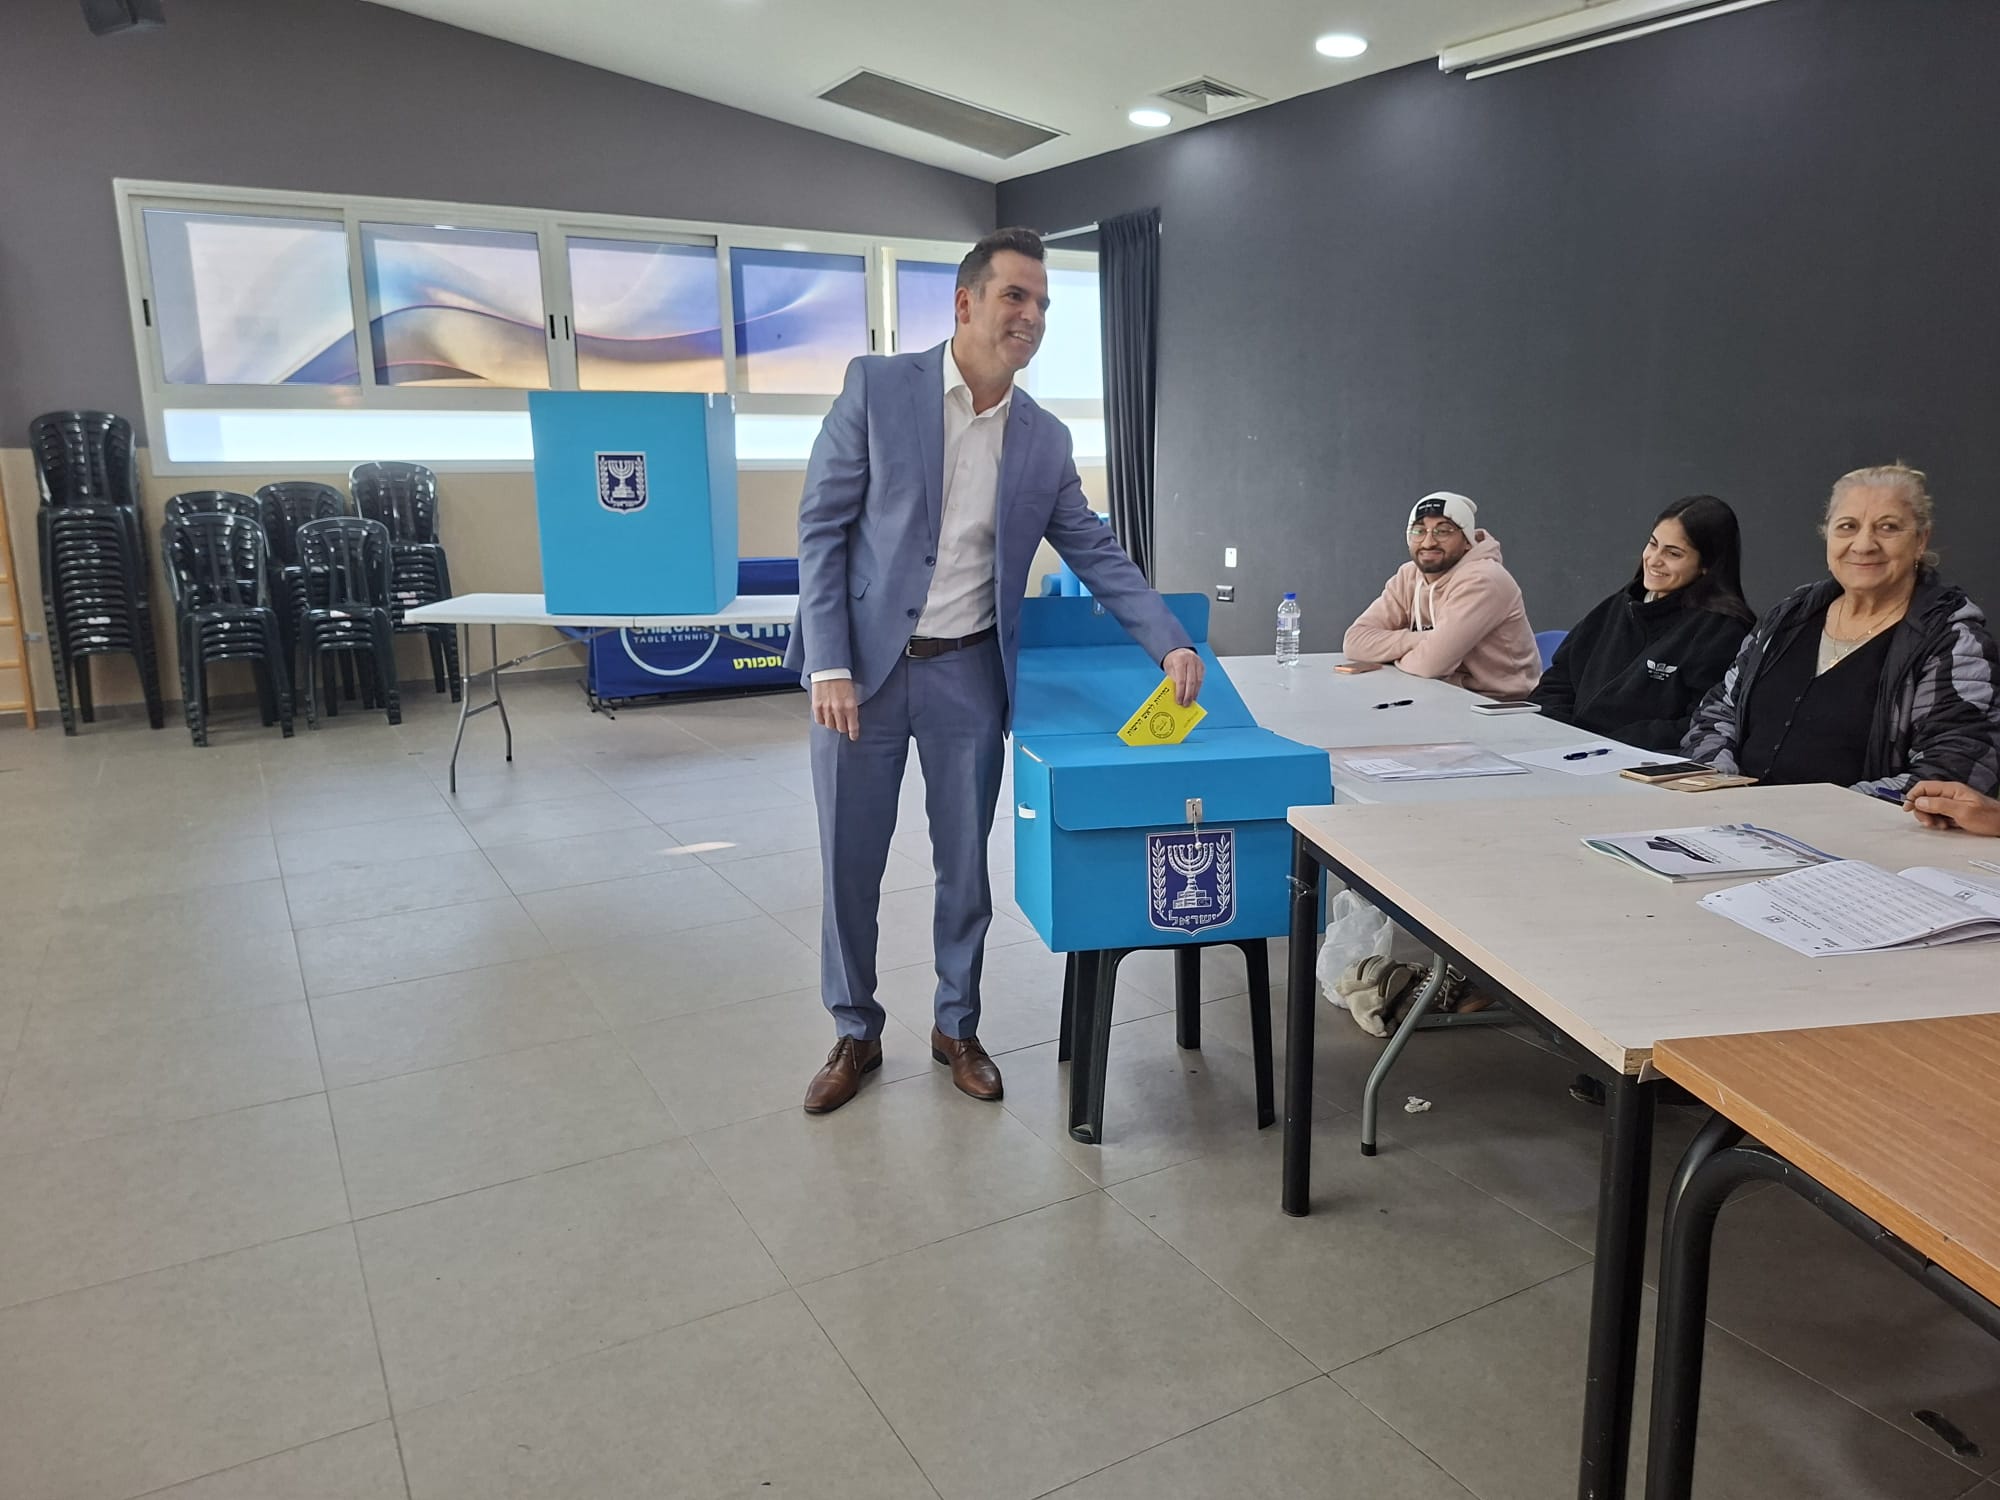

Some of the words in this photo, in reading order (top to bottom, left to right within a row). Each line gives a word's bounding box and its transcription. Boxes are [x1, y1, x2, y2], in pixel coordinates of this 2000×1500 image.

[633, 635, 667, 644] TABLE
[672, 633, 710, 642] TENNIS
[729, 624, 792, 639] CHI
[733, 655, 782, 670] וספורט
[1168, 909, 1217, 926] ישראל
